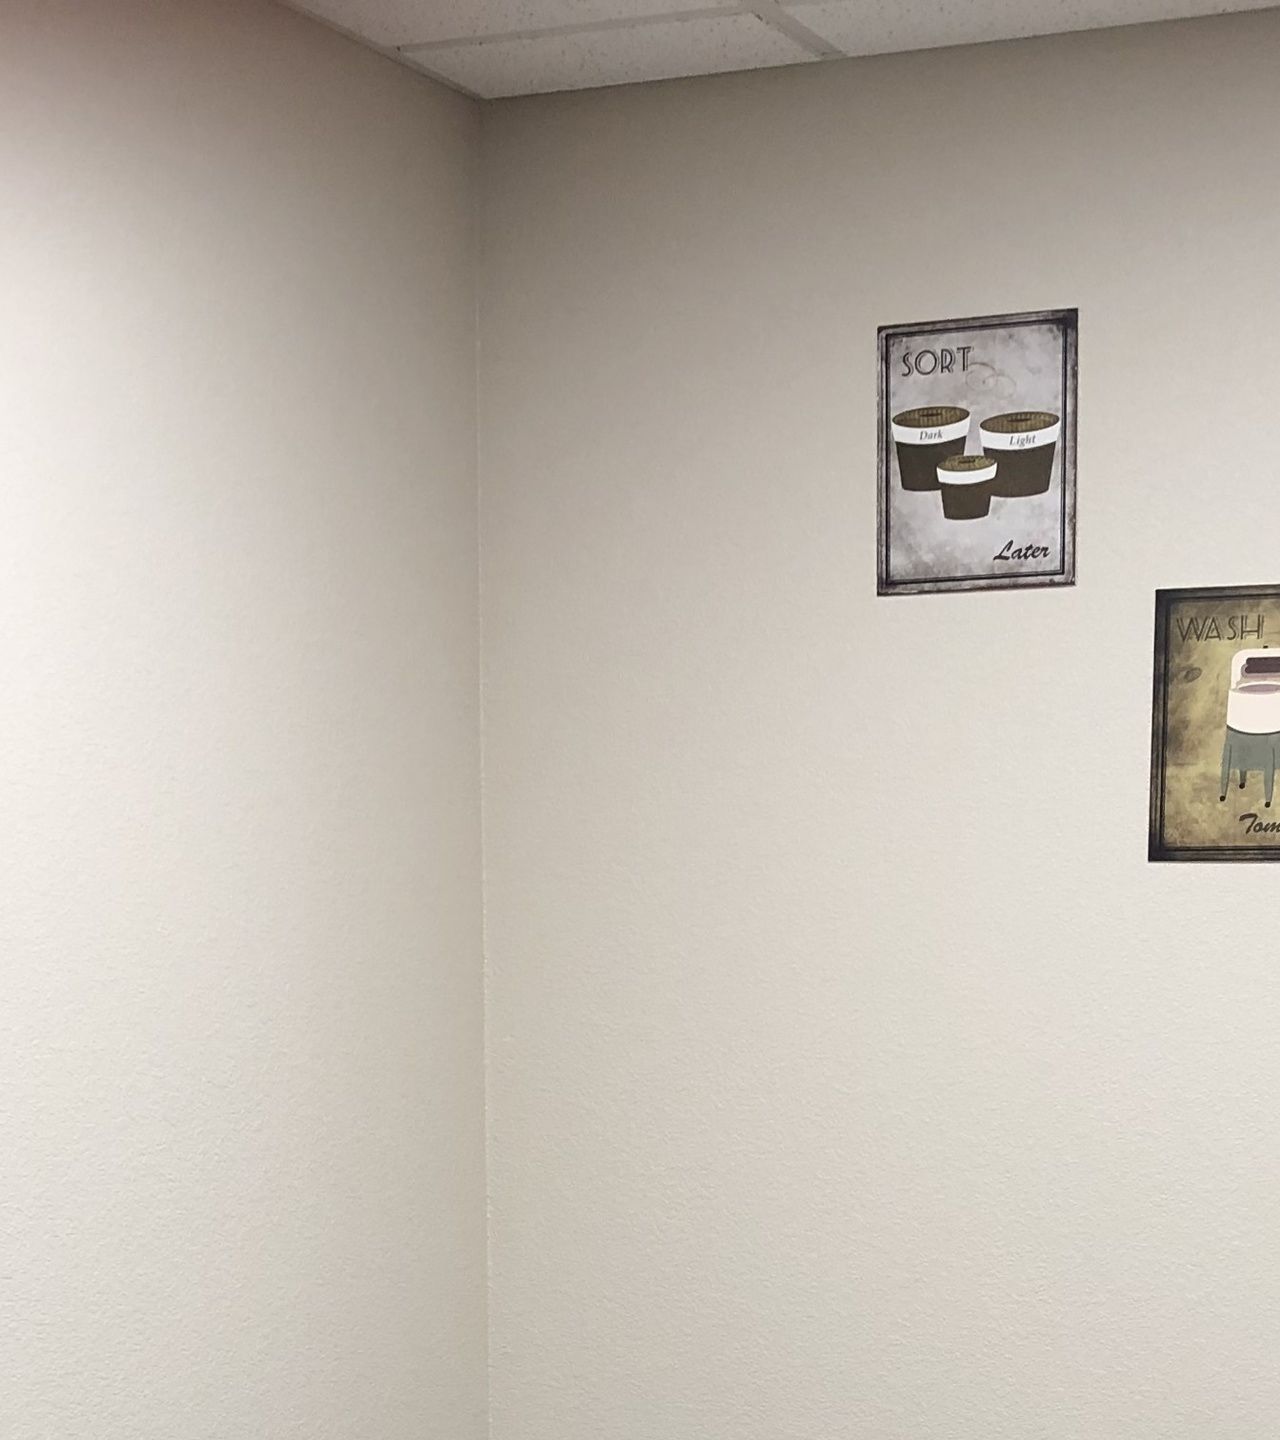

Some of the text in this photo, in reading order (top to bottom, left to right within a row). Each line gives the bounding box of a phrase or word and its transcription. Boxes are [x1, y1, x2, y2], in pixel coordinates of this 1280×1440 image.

[901, 346, 973, 377] SORT
[919, 429, 943, 441] Dark
[1008, 434, 1037, 448] Light
[992, 539, 1051, 561] Later
[1176, 614, 1264, 642] WASH
